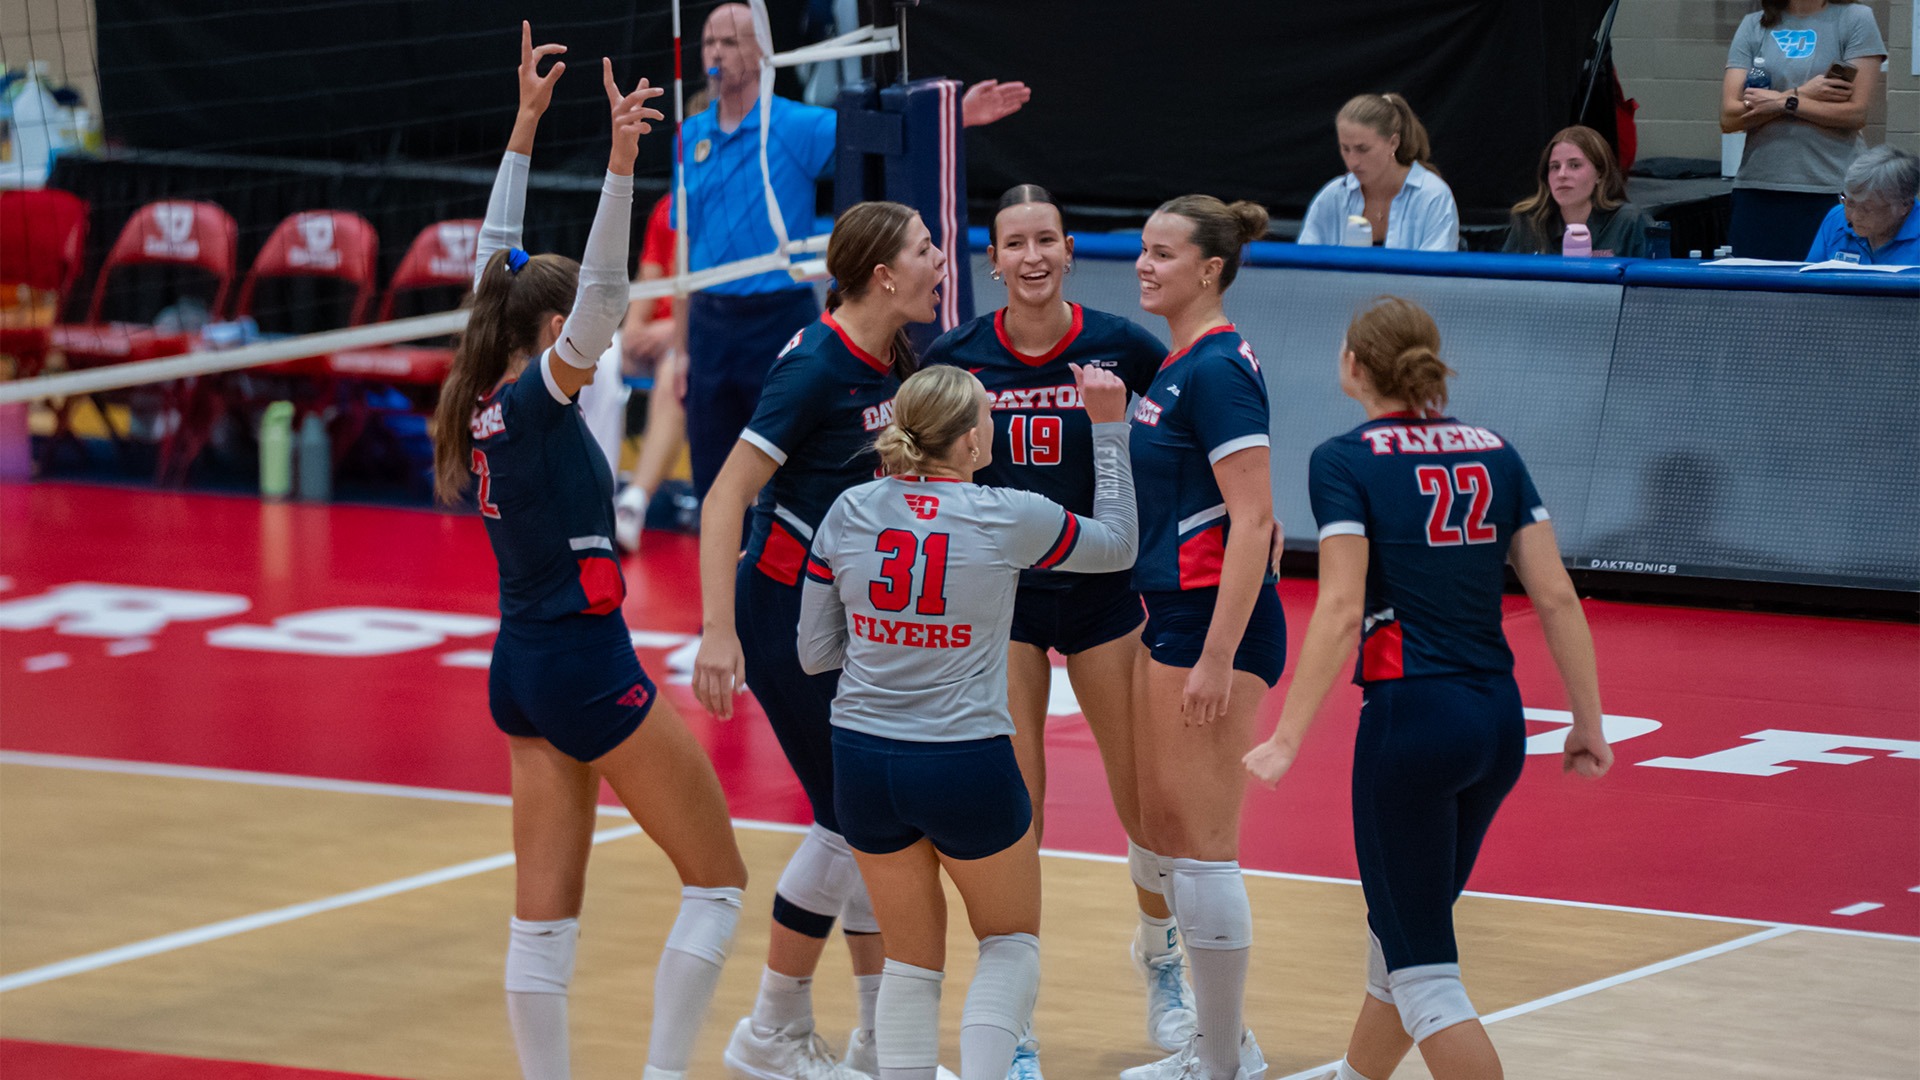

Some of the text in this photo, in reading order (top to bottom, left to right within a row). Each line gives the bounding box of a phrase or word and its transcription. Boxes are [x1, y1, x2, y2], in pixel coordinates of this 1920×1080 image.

[984, 384, 1086, 411] DAYTO
[1008, 414, 1062, 466] 19
[1361, 424, 1504, 455] FLYERS
[1415, 461, 1497, 547] 22
[869, 527, 950, 616] 31
[1591, 559, 1677, 574] DAKTRONICS
[852, 613, 972, 649] FLYERS
